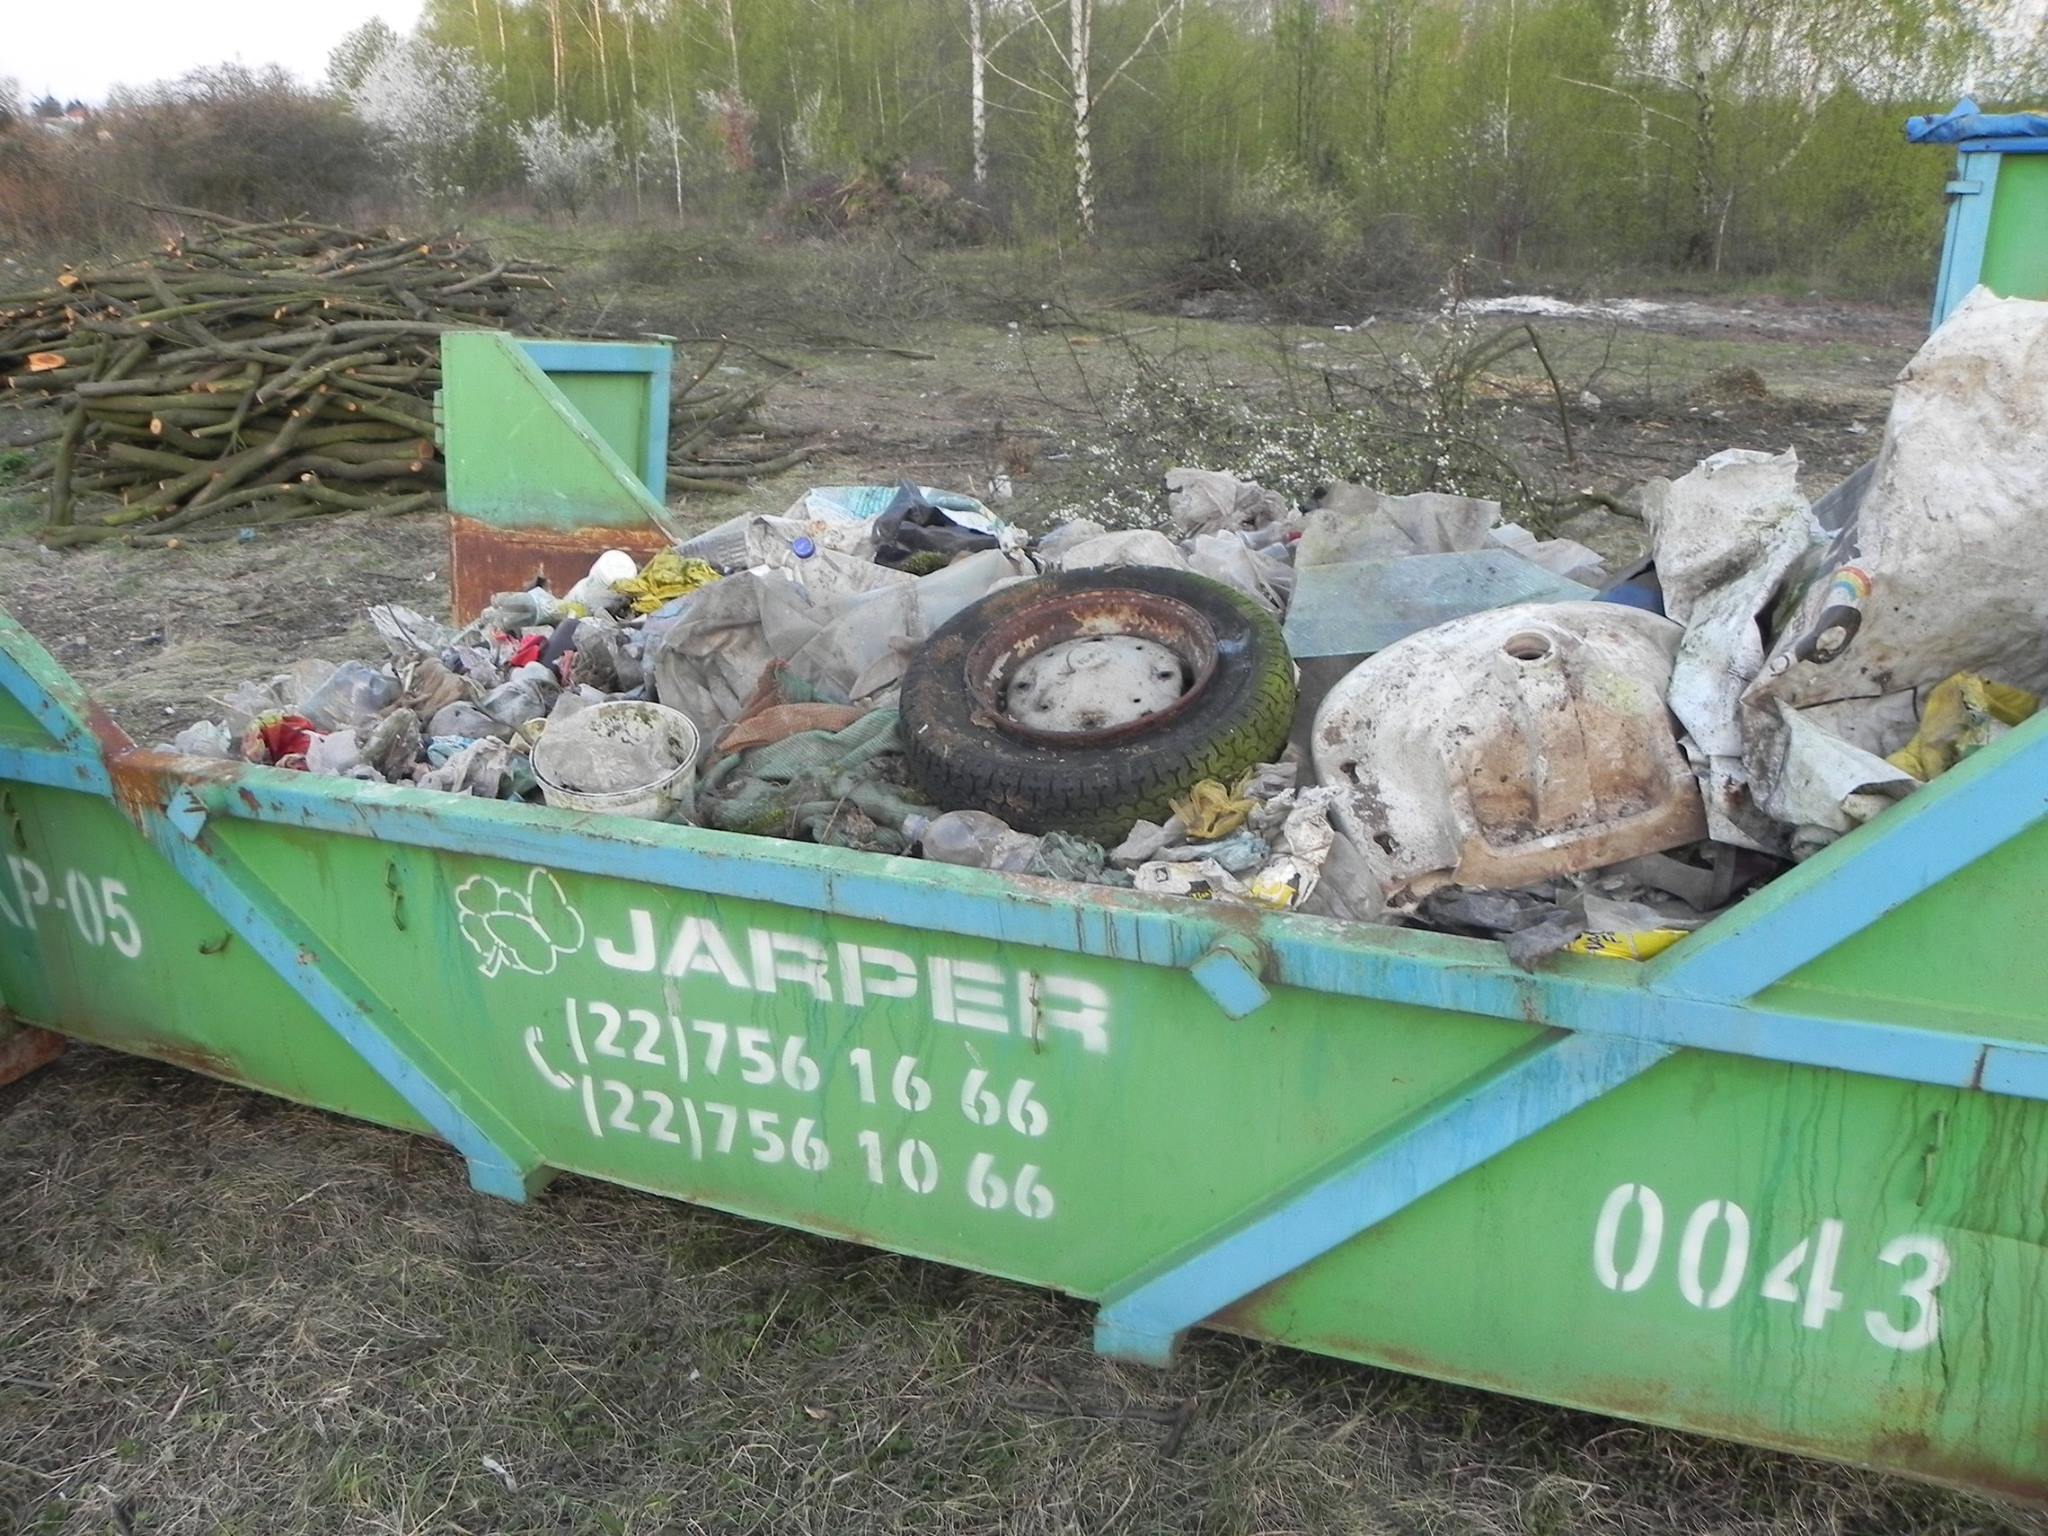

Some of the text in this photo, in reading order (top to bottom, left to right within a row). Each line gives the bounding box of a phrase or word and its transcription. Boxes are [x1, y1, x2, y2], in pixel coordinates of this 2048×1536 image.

[0, 854, 142, 958] P-05
[593, 908, 1112, 1054] JARPER
[851, 1049, 932, 1112] 16
[962, 1068, 1049, 1137] 66
[859, 1130, 939, 1195] 10
[967, 1152, 1055, 1220] 66
[1593, 1183, 1952, 1350] 0043
